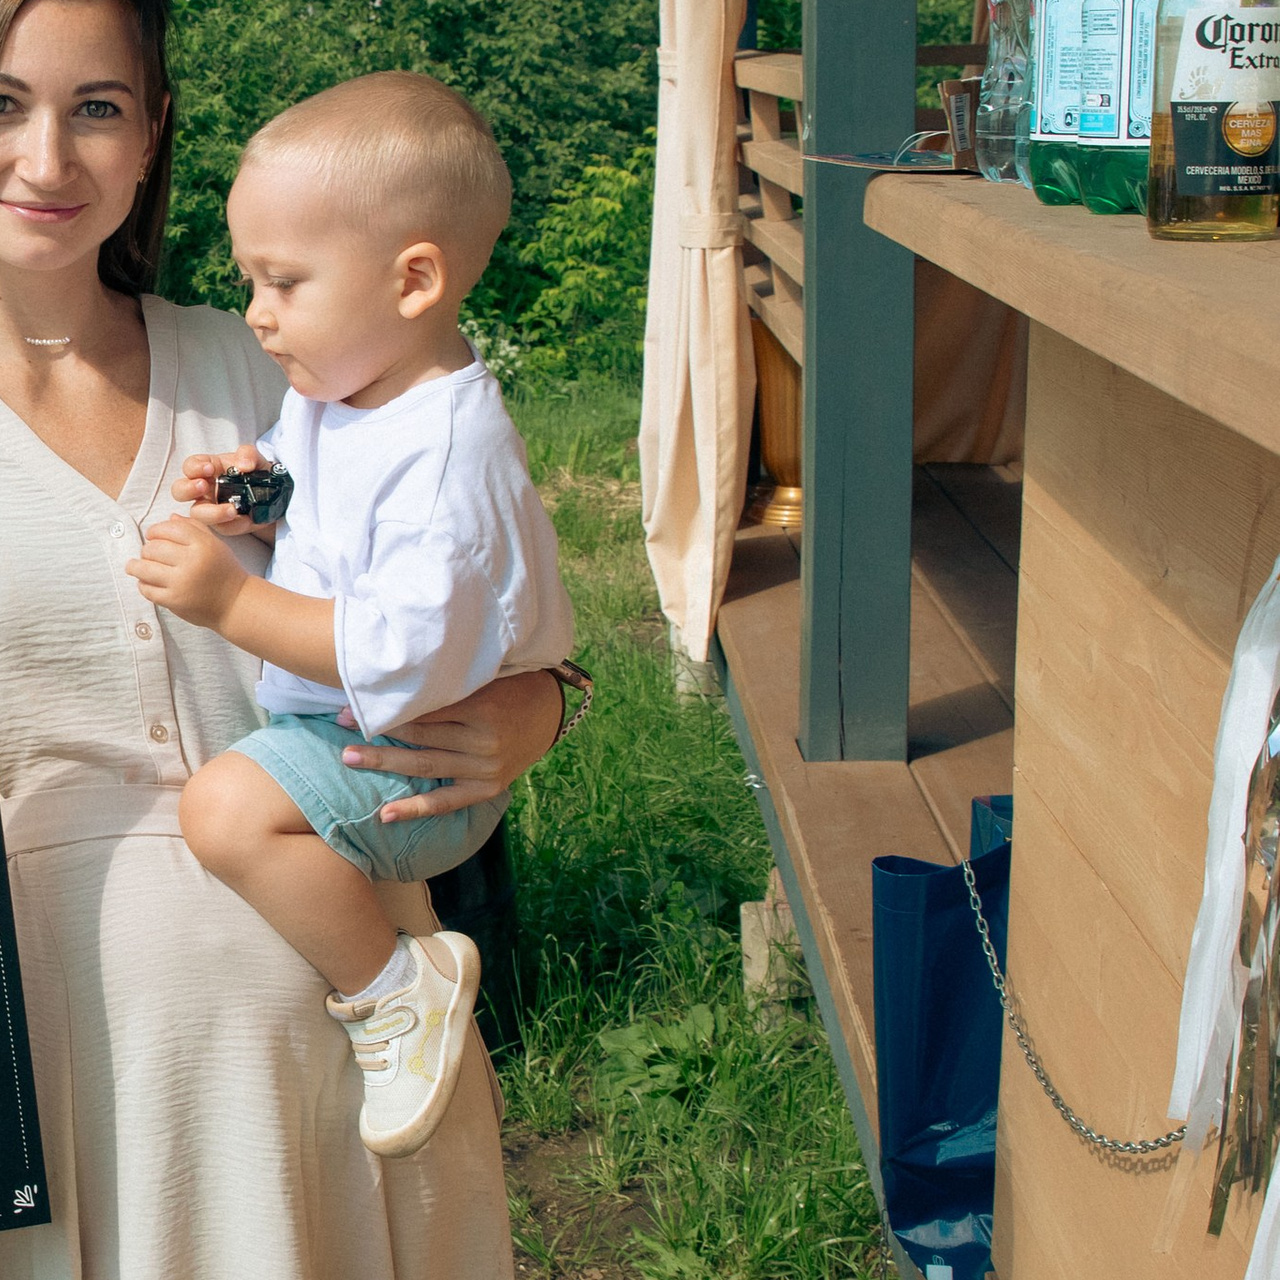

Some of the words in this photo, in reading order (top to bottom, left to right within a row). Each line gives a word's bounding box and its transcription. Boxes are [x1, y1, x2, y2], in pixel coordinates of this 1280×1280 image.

[1229, 119, 1271, 128] CERVEZA
[1241, 129, 1262, 138] MAS
[1186, 165, 1230, 175] CERVECERIA
